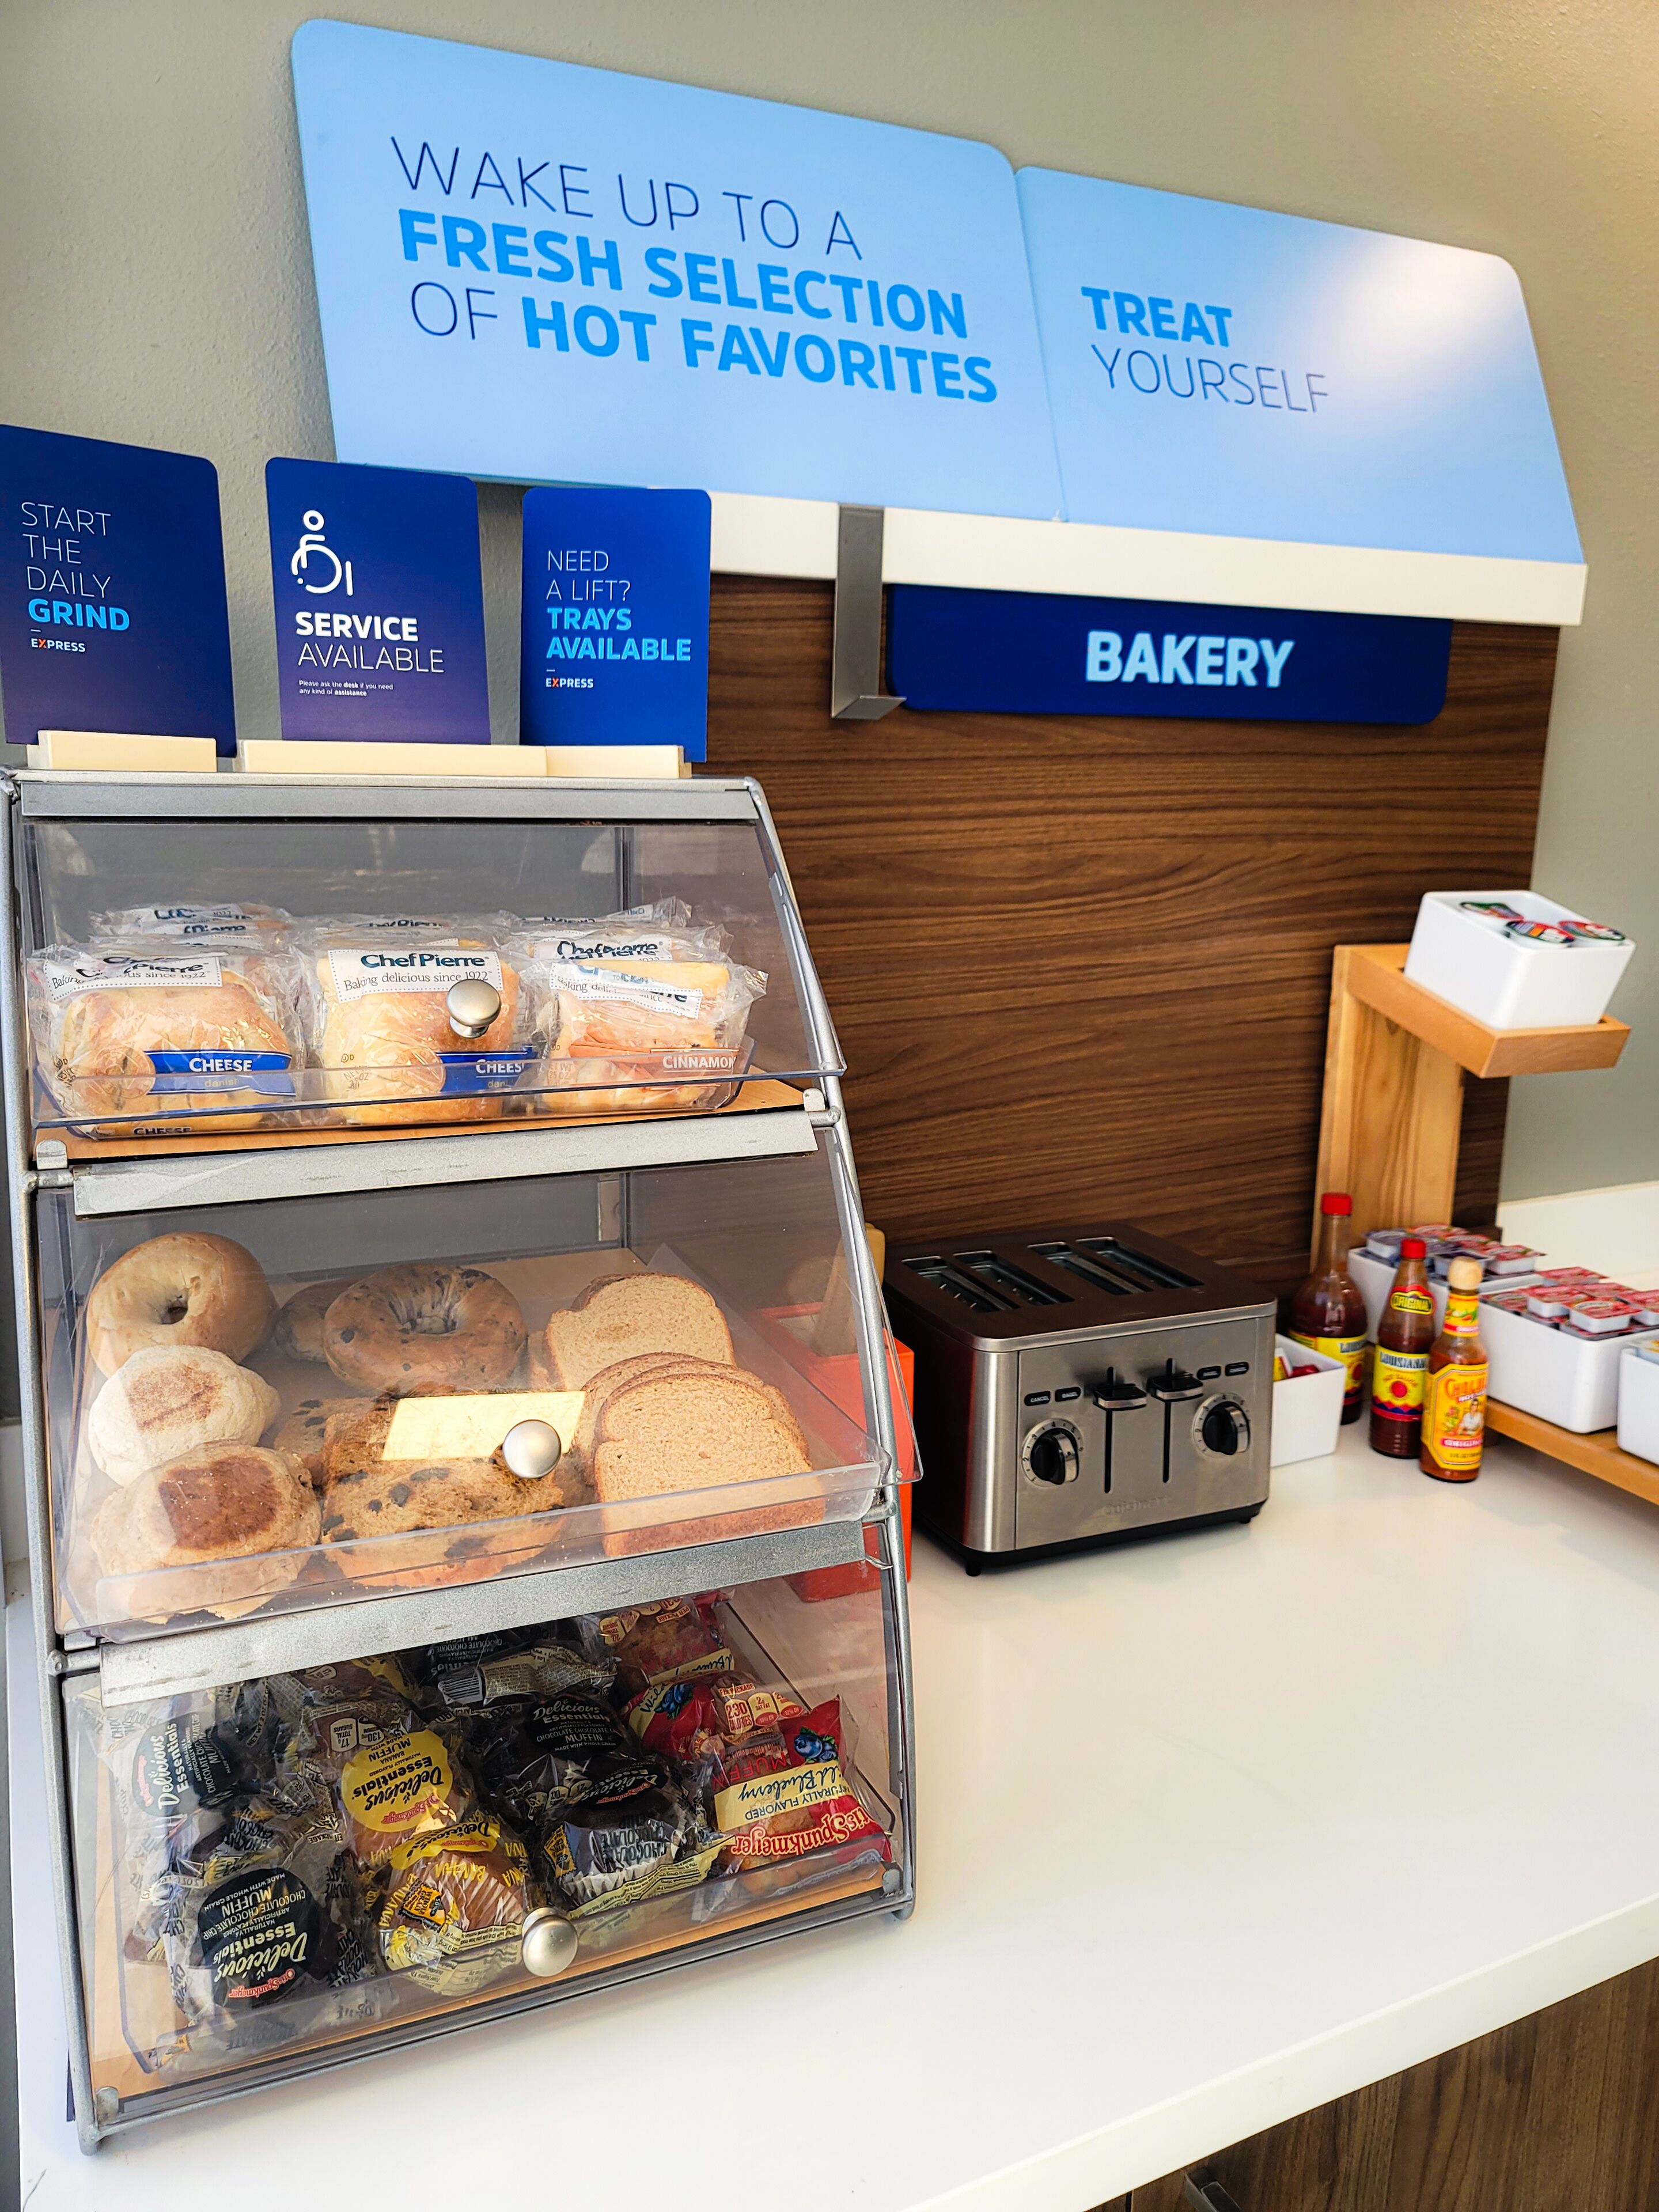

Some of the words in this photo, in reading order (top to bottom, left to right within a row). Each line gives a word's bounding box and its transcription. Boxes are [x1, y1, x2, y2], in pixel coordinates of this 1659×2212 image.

[391, 137, 594, 218] WAKE
[619, 175, 699, 231] UP
[723, 191, 799, 249] TO
[826, 210, 863, 260] A
[398, 209, 622, 290] FRESH
[645, 247, 968, 339] SELECTION
[1081, 286, 1232, 347] TREAT
[411, 282, 498, 340] OF
[522, 297, 656, 362] HOT
[681, 319, 998, 403] FAVORITES
[1092, 344, 1328, 413] YOURSELF
[21, 502, 111, 536] START
[22, 534, 81, 564] THE
[548, 550, 609, 571] NEED
[27, 566, 111, 599] DAILY
[546, 579, 562, 600] A
[572, 579, 631, 601] LIFT?
[28, 598, 130, 631] GRIND
[295, 611, 418, 642] SERVICE
[547, 608, 632, 631] TRAYS
[31, 638, 86, 653] EXPRESS
[298, 642, 444, 673] AVAILABLE
[546, 637, 691, 661] AVAILABLE
[1086, 630, 1294, 687] BAKERY
[546, 677, 594, 688] EXPRESS
[344, 976, 378, 991] Baking
[382, 971, 430, 983] delicious
[434, 972, 461, 982] since
[465, 971, 488, 981] 1922
[189, 1058, 252, 1072] CHEESE
[476, 1059, 524, 1074] CHEES
[1392, 1296, 1431, 1311] ORIGINAL
[533, 1700, 600, 1721] Delicious
[726, 1702, 748, 1719] 230
[247, 1734, 258, 1747] NET
[256, 1722, 263, 1733] WT
[334, 1724, 353, 1733] SUGARS
[336, 1730, 351, 1738] TOTAL
[385, 1736, 403, 1745] MADE
[537, 1728, 574, 1742] CHOCOLATE
[565, 1734, 603, 1743] MUFFIN
[164, 1723, 190, 1793] Essentials
[369, 1737, 411, 1762] MUFFIN
[371, 1741, 385, 1751] WITH
[380, 1751, 405, 1764] BANANA
[369, 1763, 394, 1777] FLAVORED
[395, 1753, 421, 1766] NATURALLY
[712, 1752, 788, 1790] MUFFN
[150, 1735, 180, 1810] Delicious
[199, 1756, 216, 1793] CHOCOLATE
[353, 1756, 432, 1797] Essentials
[738, 1768, 817, 1801] Blueberry
[365, 1766, 444, 1810] Delicious
[745, 1796, 799, 1820] FLAVORED
[249, 1880, 267, 1891] WITH
[266, 1872, 285, 1884] MADE
[204, 1897, 225, 1912] GRAIN
[222, 1886, 272, 1918] MUFFIN
[225, 1887, 249, 1900] WHOLE
[260, 1889, 306, 1913] CHOCOLATE
[217, 1905, 259, 1931] CHOCOLATE
[239, 1918, 275, 1937] NATURALLY
[248, 1906, 290, 1926] ARTIFICIALLY
[203, 1926, 217, 1940] CHIP
[213, 1921, 296, 1964] Essentials
[214, 1932, 308, 1983] Delicious
